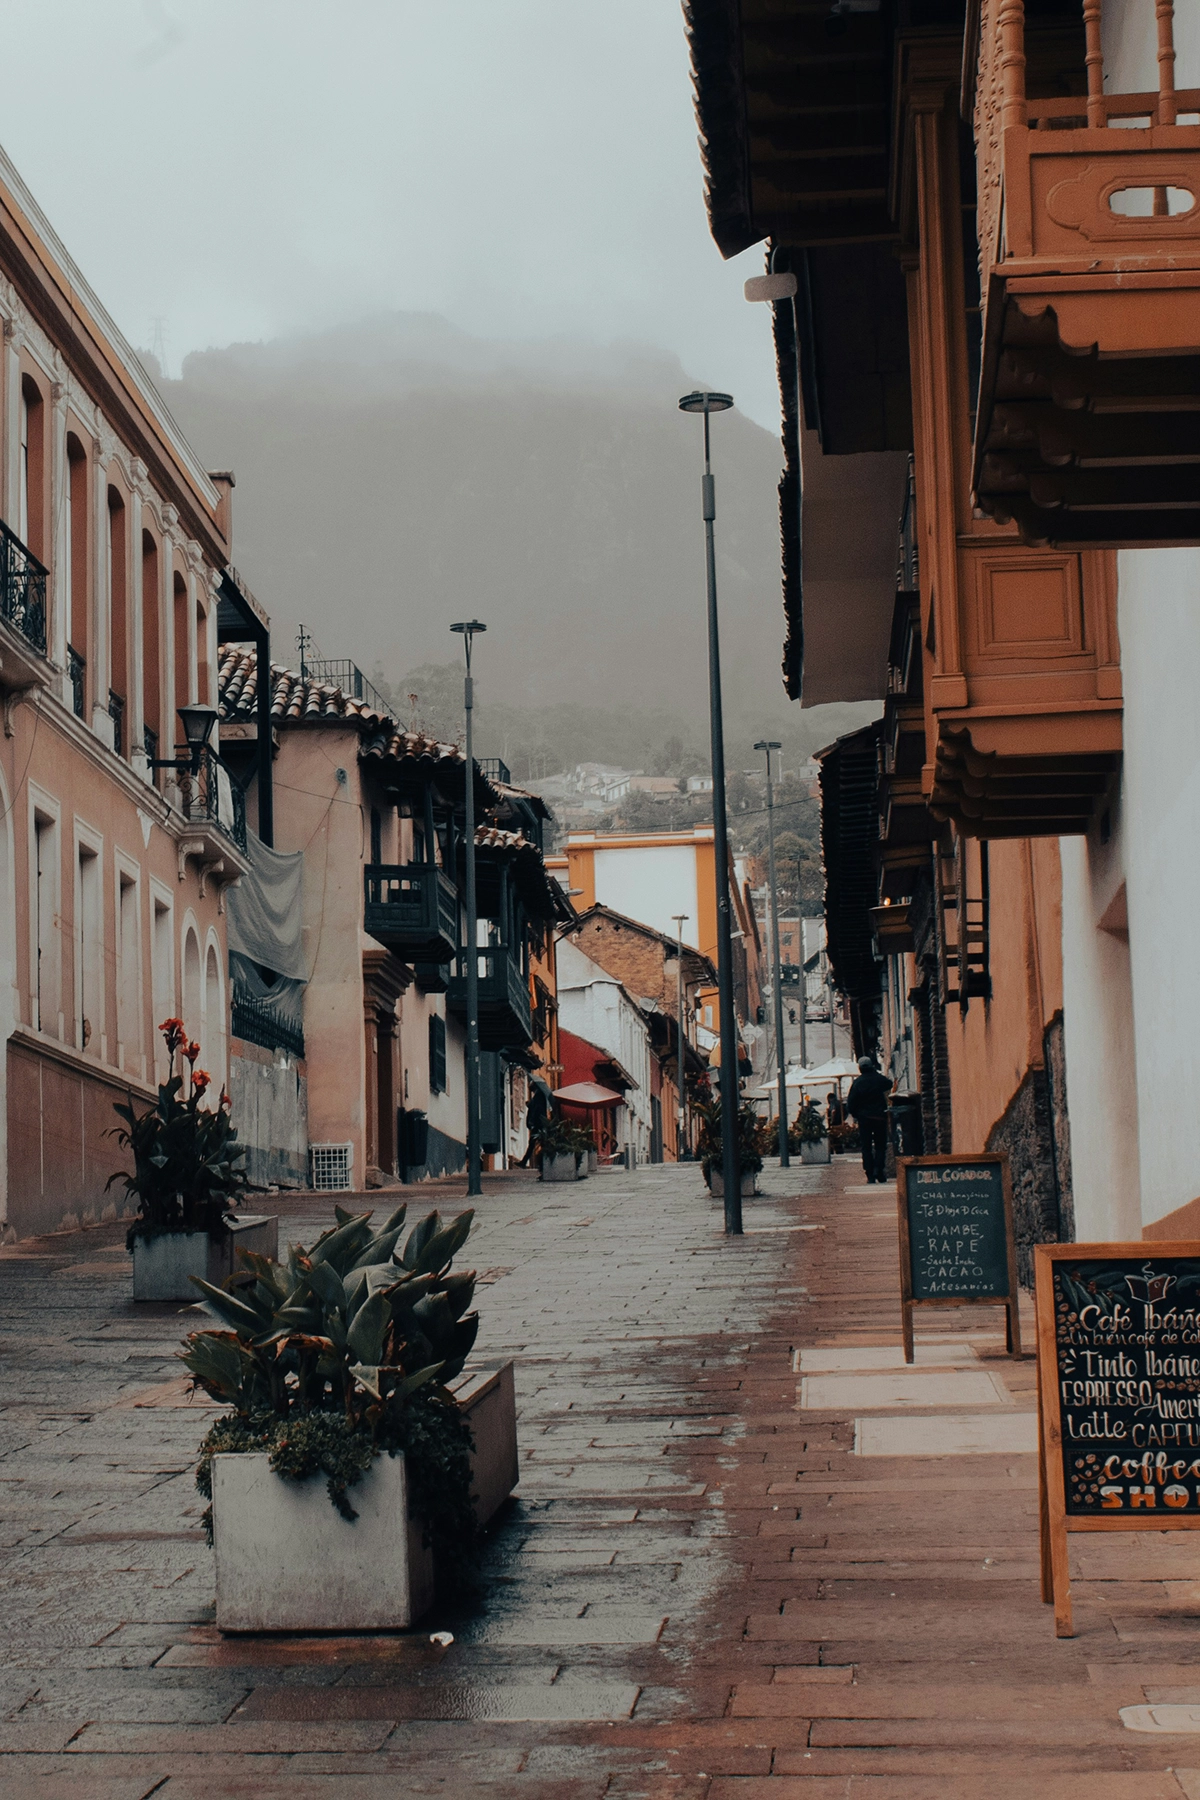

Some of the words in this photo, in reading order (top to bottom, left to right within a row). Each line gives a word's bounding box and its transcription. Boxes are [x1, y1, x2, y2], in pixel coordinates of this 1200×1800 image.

[917, 1170, 942, 1184] DEL
[1079, 1303, 1133, 1334] Café
[1127, 1331, 1156, 1350] café
[1161, 1329, 1179, 1345] de
[1079, 1349, 1138, 1378] Tinto
[1061, 1380, 1153, 1407] ESPRESSO
